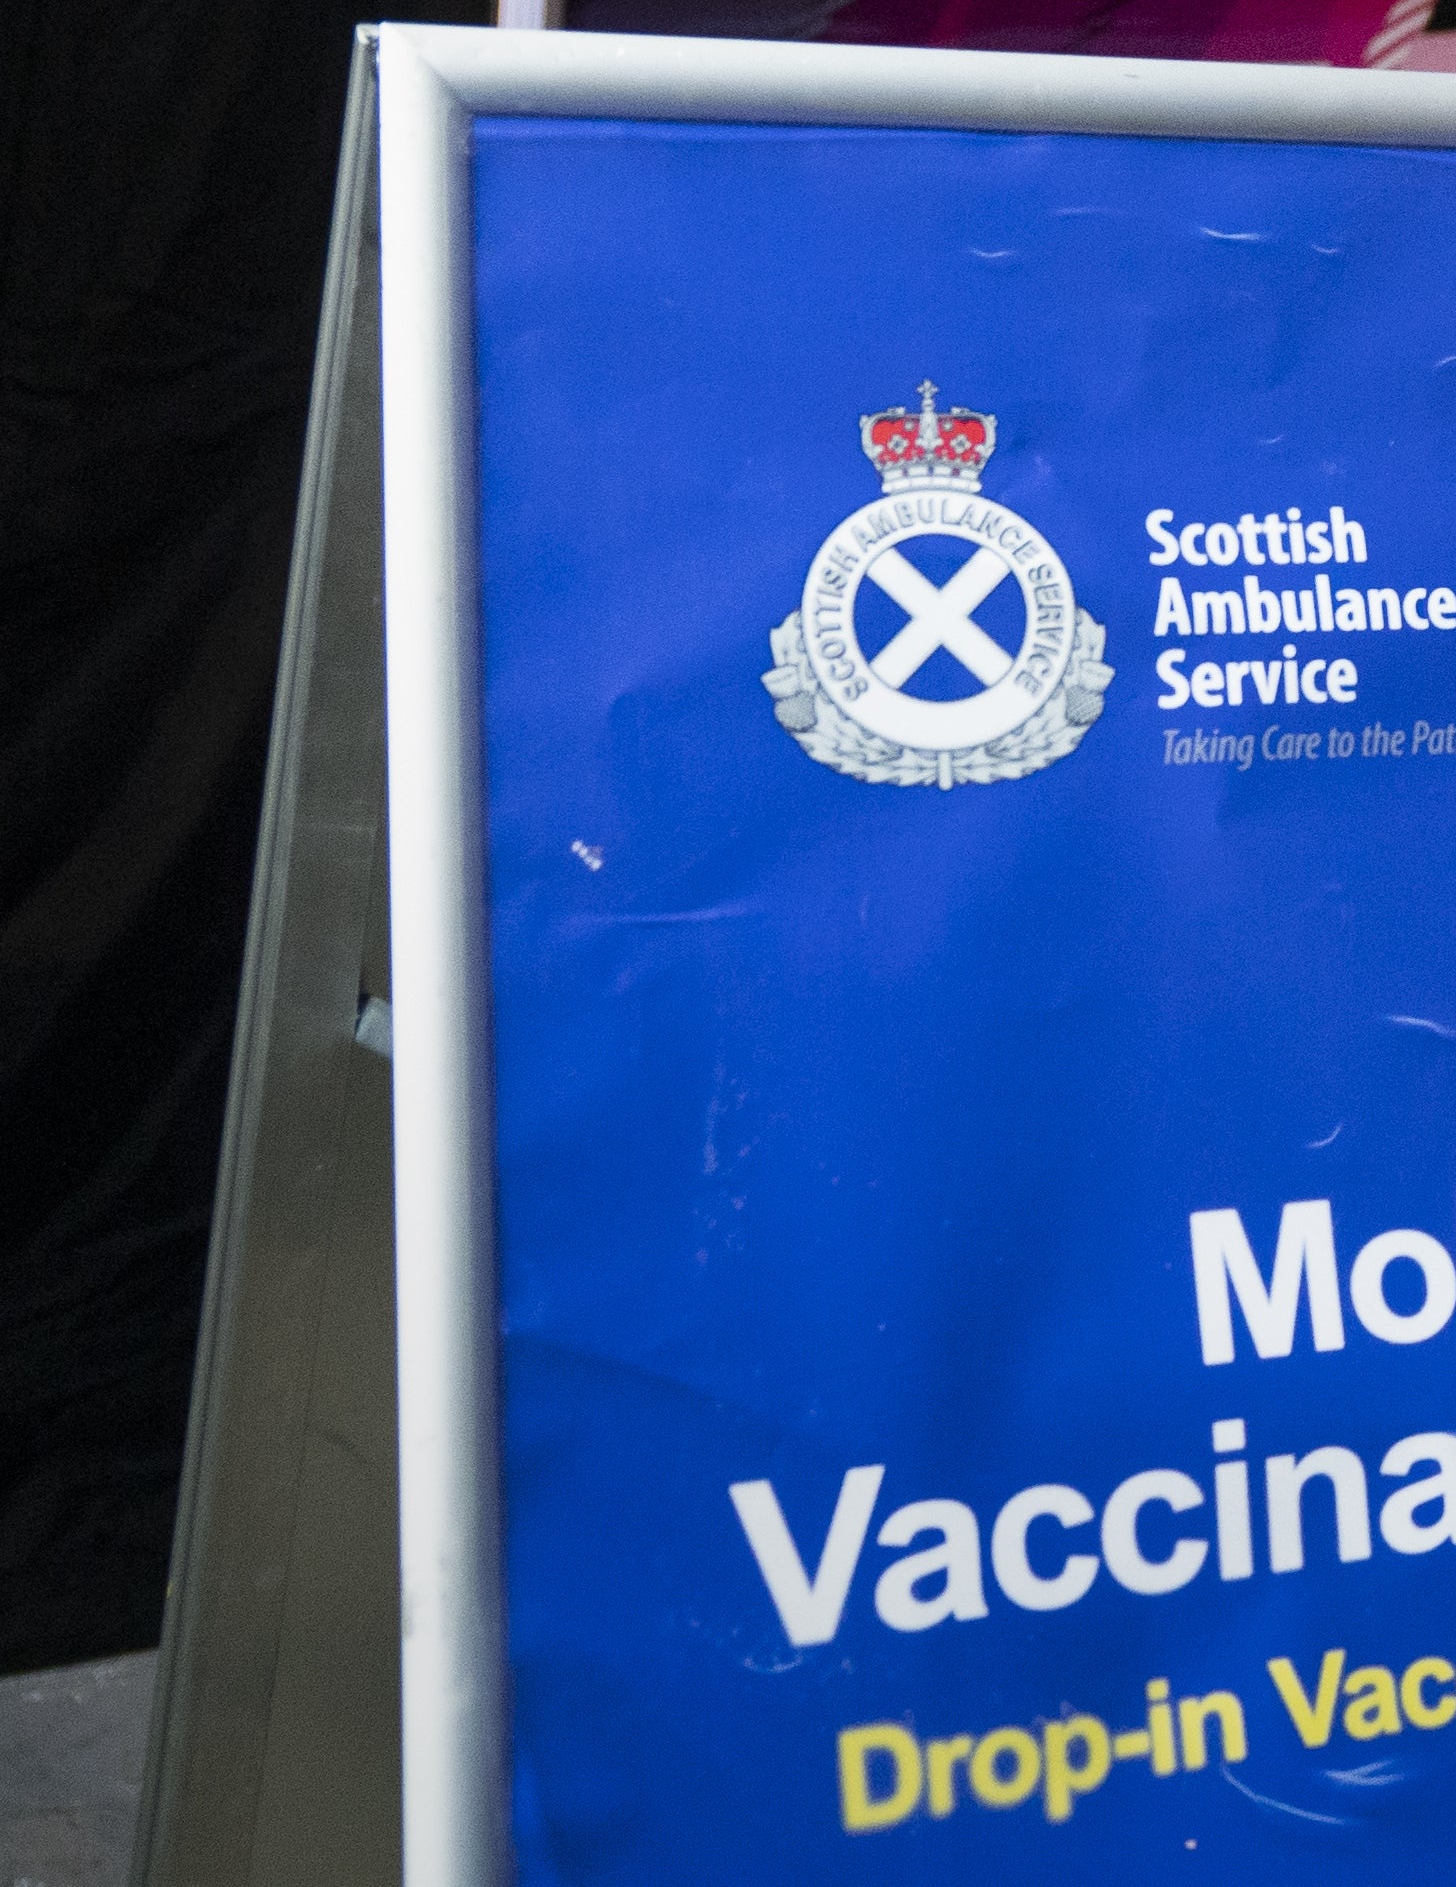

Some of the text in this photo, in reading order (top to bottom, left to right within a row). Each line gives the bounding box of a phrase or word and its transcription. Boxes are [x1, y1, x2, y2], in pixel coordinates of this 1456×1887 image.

[1145, 505, 1368, 566] Scottish
[814, 497, 1065, 702] SCOTTISH AMBULANCE SERVICE
[1155, 644, 1358, 710] Service
[1162, 727, 1256, 772] Taking
[1261, 723, 1322, 761] Care
[1327, 726, 1356, 759] to
[1361, 721, 1406, 757] the
[835, 1676, 1249, 1835] Drop-in
